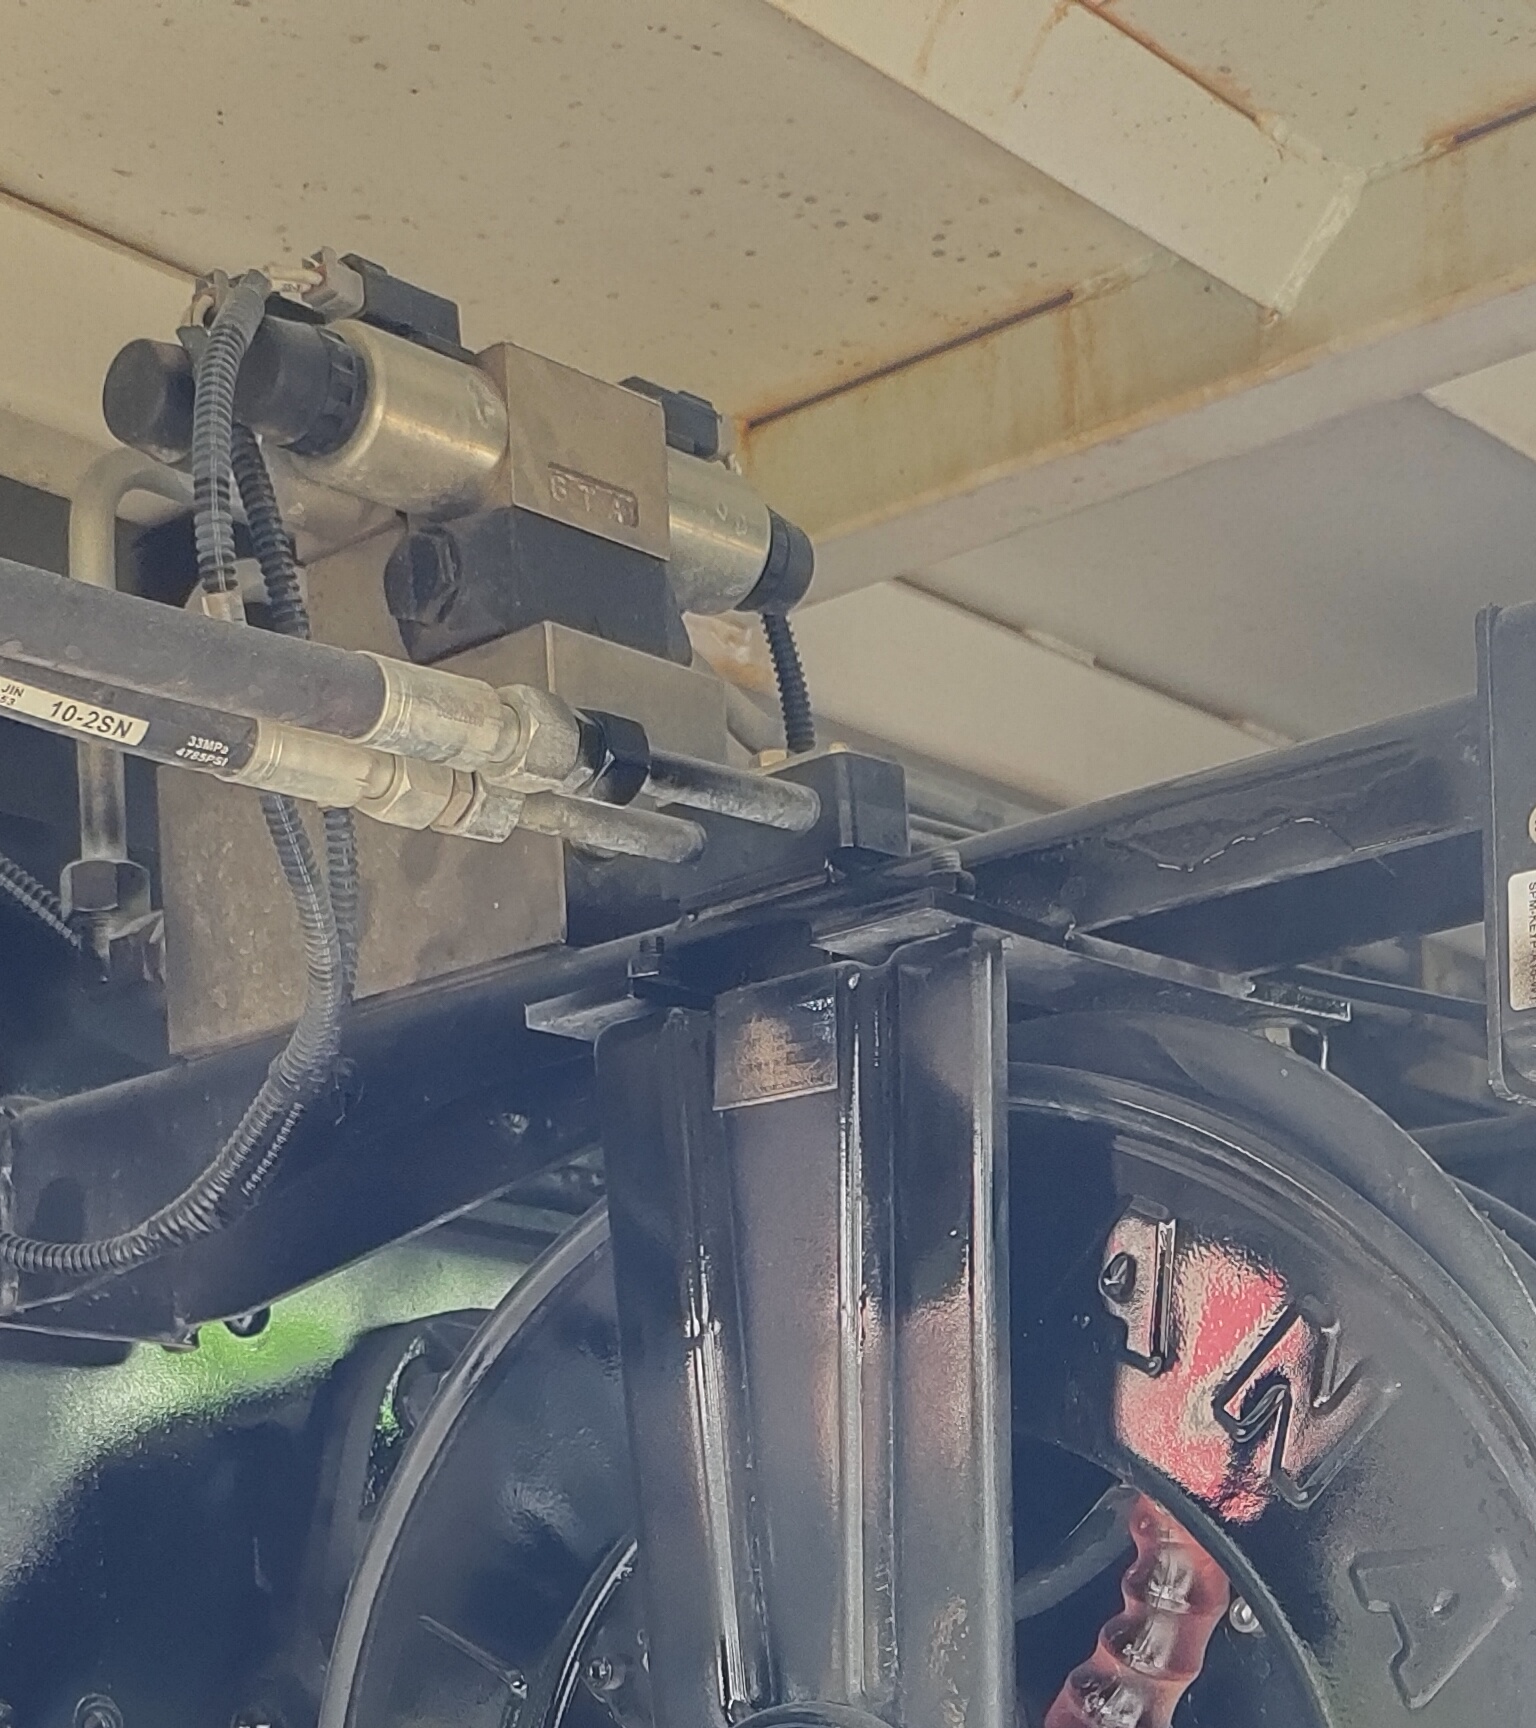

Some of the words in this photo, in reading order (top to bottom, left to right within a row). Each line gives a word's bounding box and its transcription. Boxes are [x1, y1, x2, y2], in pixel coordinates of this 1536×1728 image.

[1, 684, 25, 698] JIN
[50, 700, 133, 739] 10-2SN
[186, 734, 230, 755] 33MPa
[175, 747, 229, 767] 4785PSI
